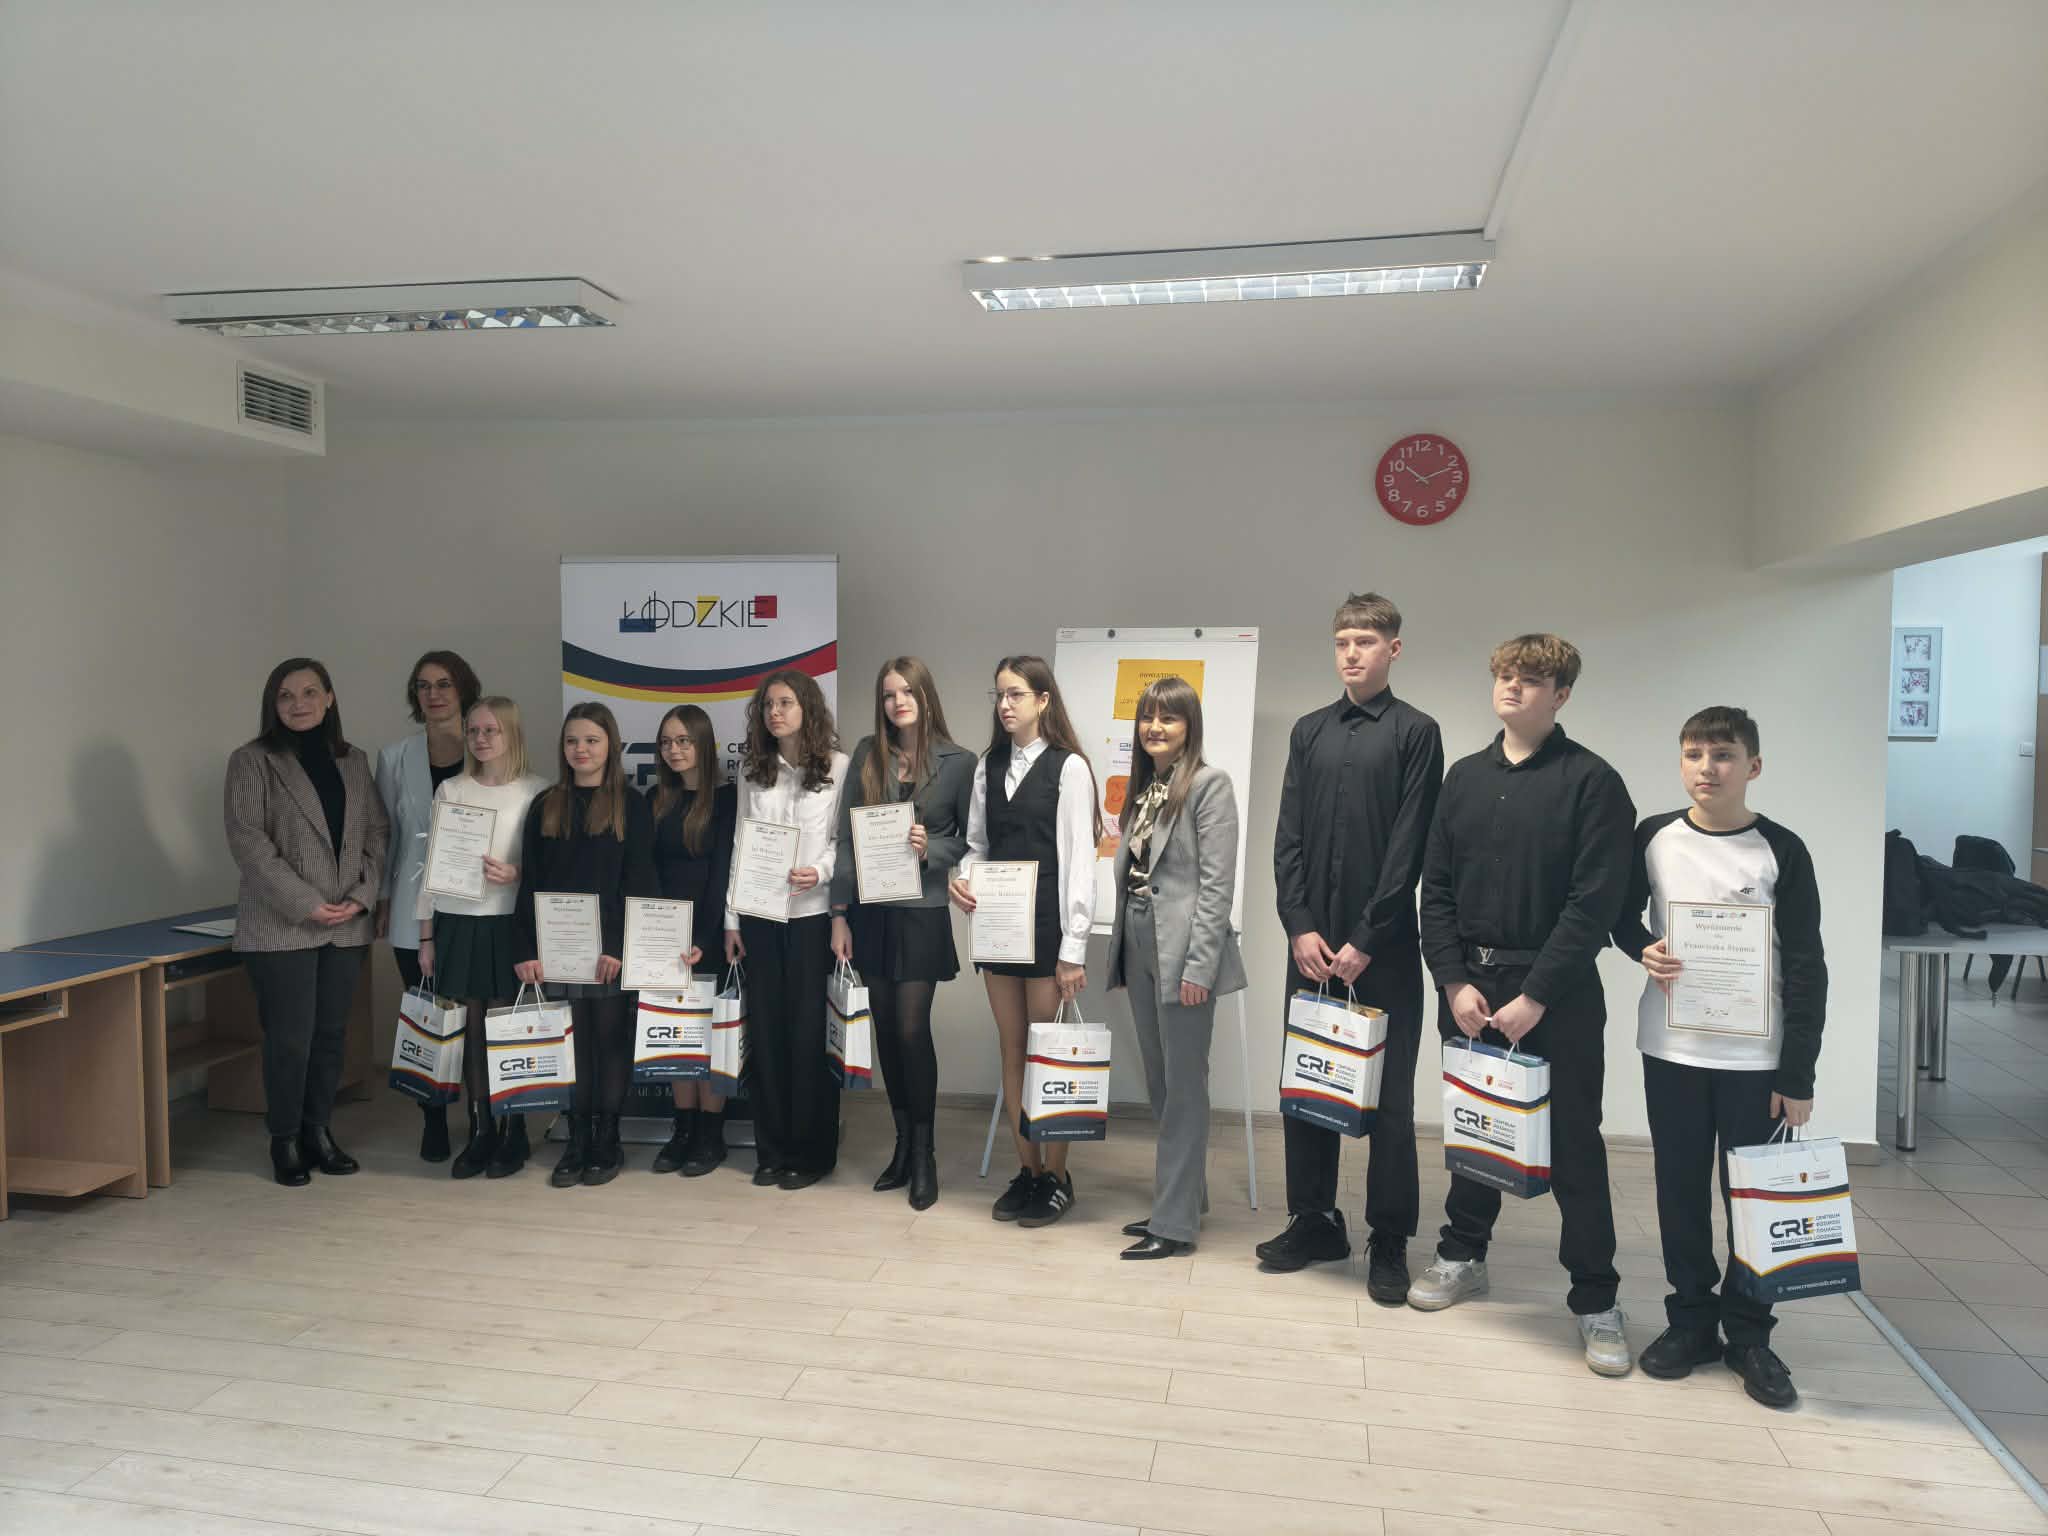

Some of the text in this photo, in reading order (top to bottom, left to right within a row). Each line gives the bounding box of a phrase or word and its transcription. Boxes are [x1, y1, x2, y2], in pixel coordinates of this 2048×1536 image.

[1414, 440, 1431, 451] 12
[1437, 444, 1444, 456] 1
[1400, 447, 1413, 458] 11
[1389, 460, 1405, 472] 10
[1448, 456, 1458, 467] 2
[1383, 474, 1395, 487] 9
[1452, 471, 1463, 483] 3
[1388, 489, 1400, 501] 8
[1445, 487, 1457, 499] 4
[1402, 501, 1412, 512] 7
[1416, 505, 1429, 518] 6
[1435, 500, 1446, 512] 5
[647, 1027, 682, 1039] CRE
[500, 1057, 536, 1071] CRE
[1297, 1053, 1335, 1075] CRE
[1042, 1081, 1077, 1095] CRE
[1454, 1107, 1492, 1131] CRE
[1769, 1217, 1814, 1239] CRE
